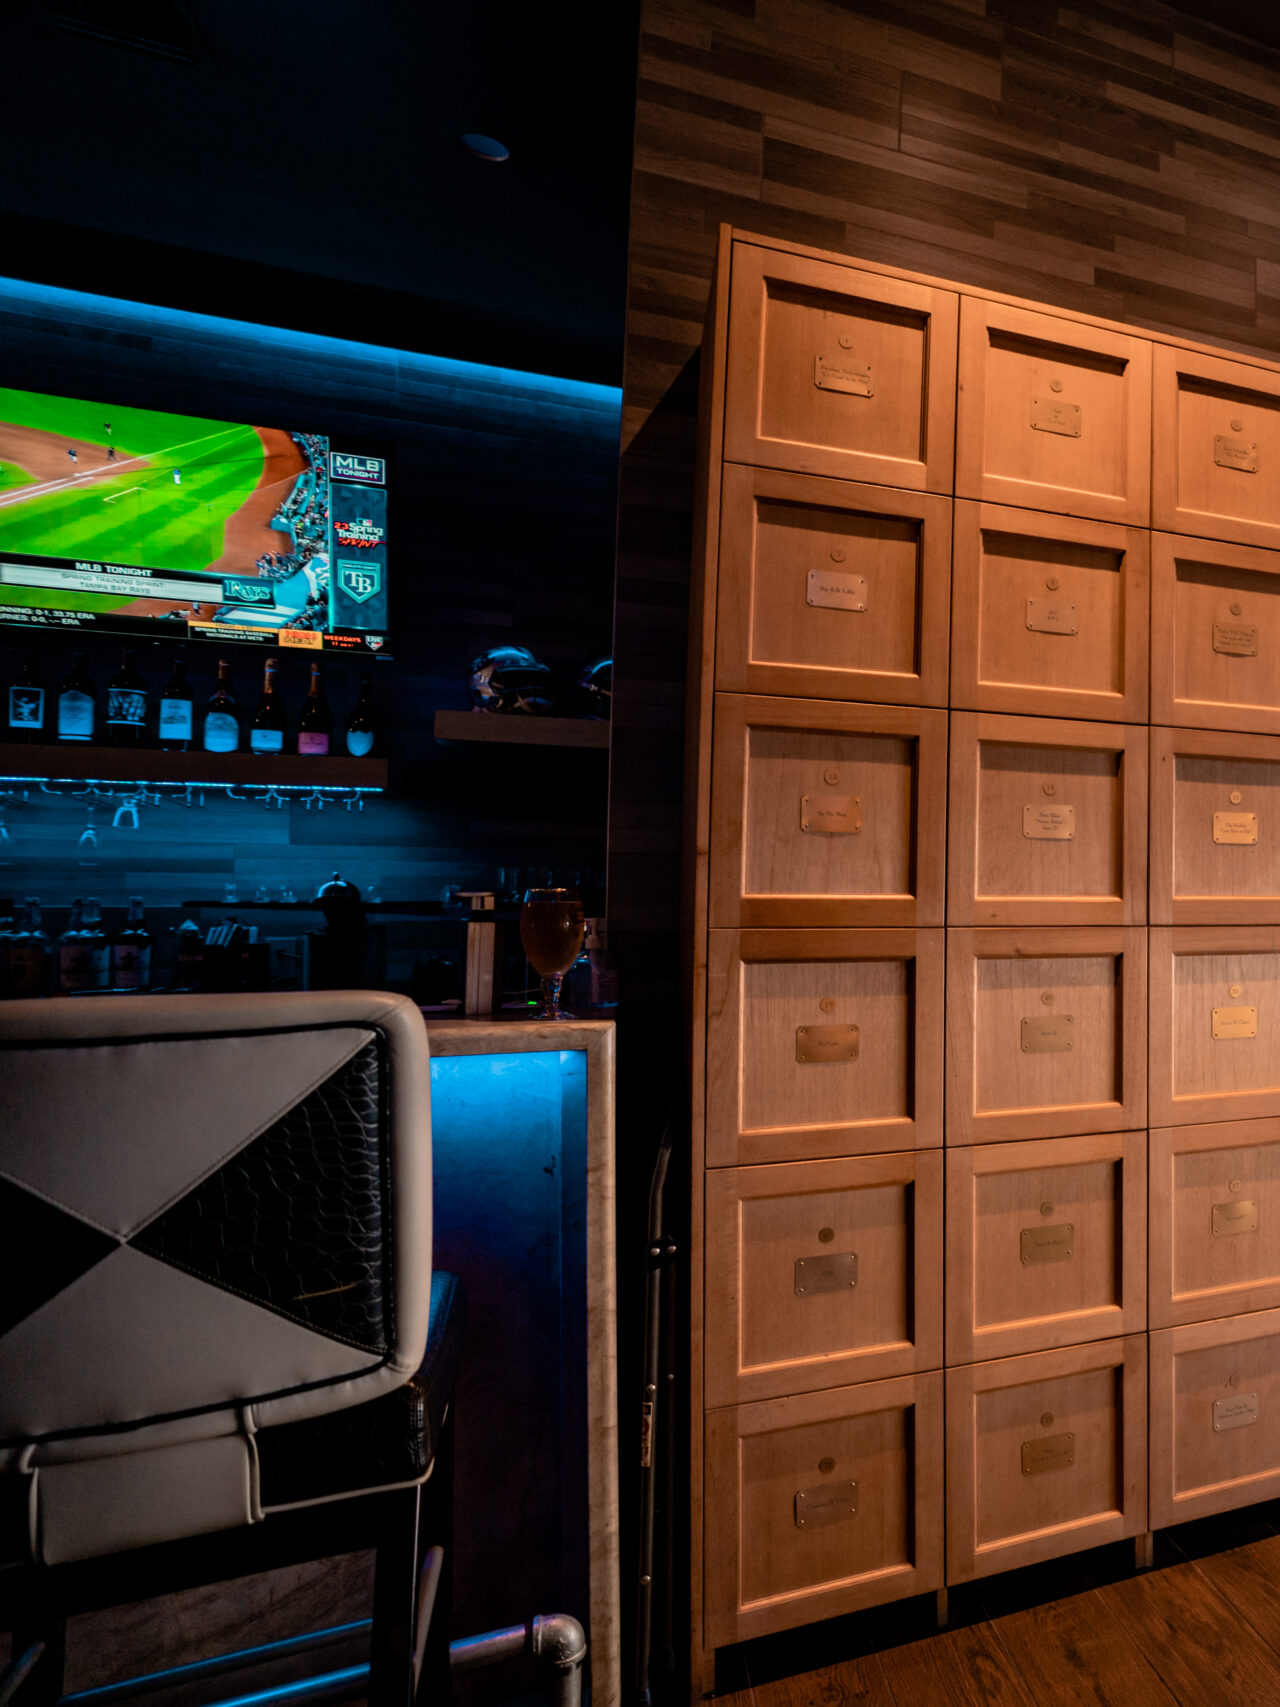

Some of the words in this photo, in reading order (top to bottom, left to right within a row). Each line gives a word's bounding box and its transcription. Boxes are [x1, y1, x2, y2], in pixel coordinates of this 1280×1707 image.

[336, 456, 380, 472] MLB
[337, 468, 380, 480] TONIGHT
[334, 521, 349, 531] 23
[349, 522, 384, 537] Spring
[337, 529, 379, 542] Training
[75, 562, 103, 572] MLB
[104, 564, 153, 577] TONIGHT
[95, 575, 134, 585] TRAINING
[129, 586, 151, 594] RAYS
[76, 611, 97, 620] ERA
[61, 617, 82, 626] ERA
[323, 635, 362, 643] WEEKDAYS
